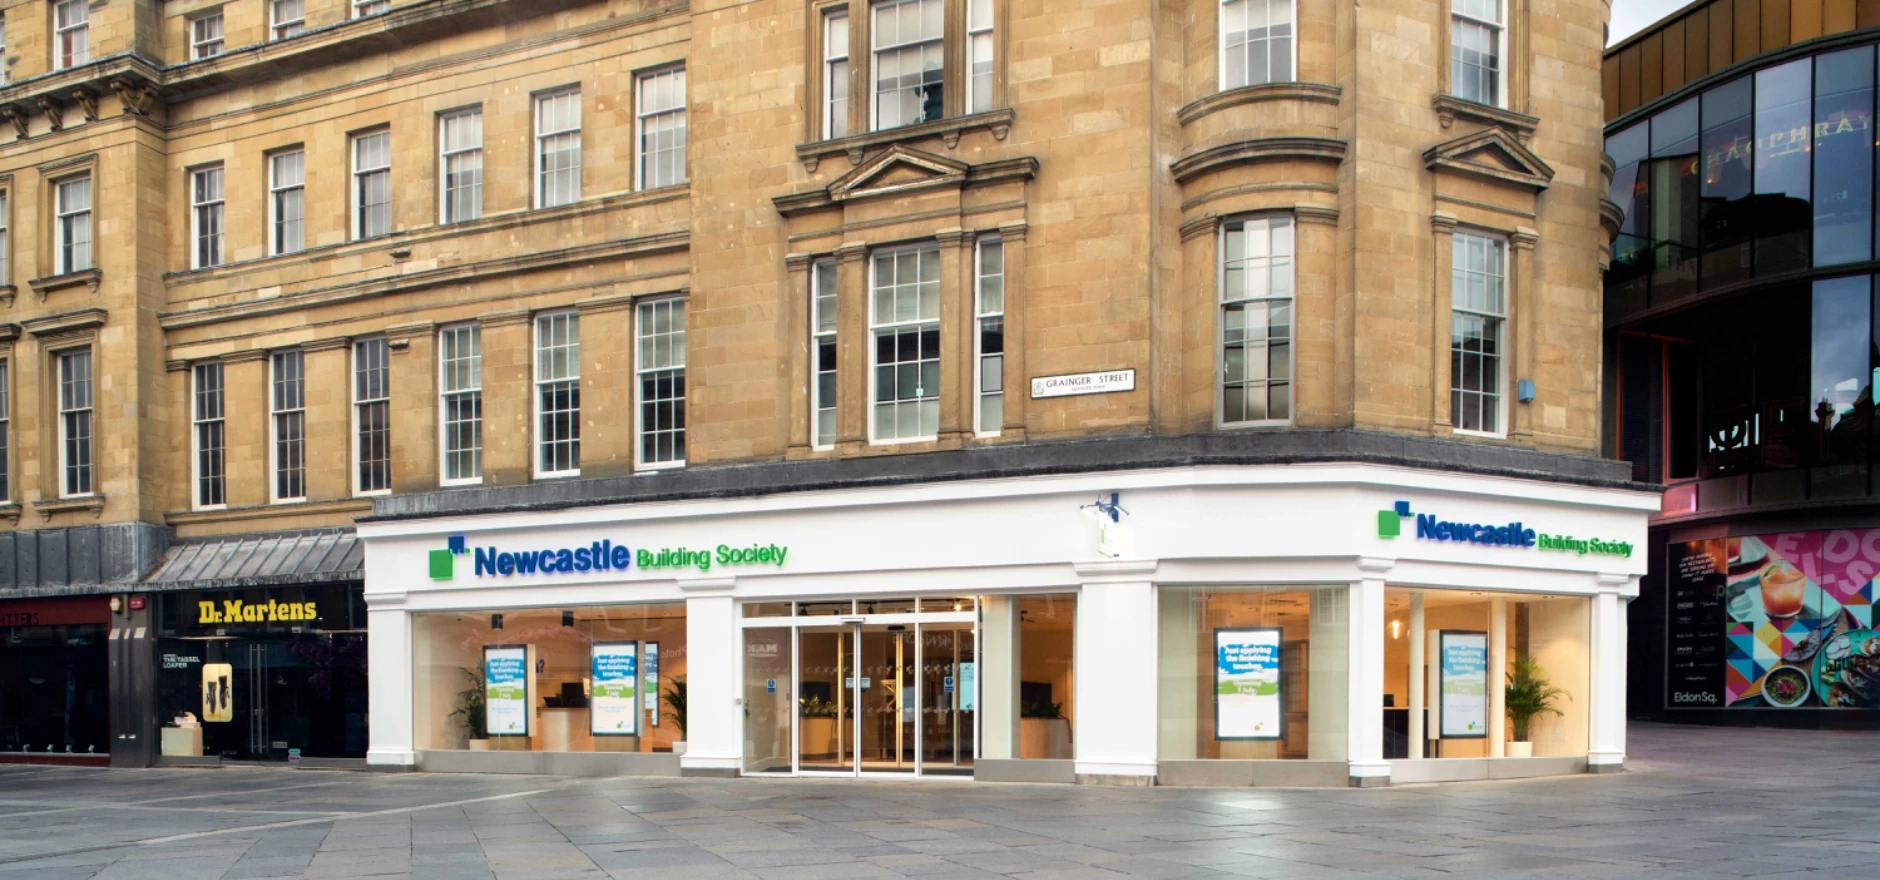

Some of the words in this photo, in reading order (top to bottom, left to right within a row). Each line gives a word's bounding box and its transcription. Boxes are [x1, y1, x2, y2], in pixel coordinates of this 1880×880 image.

[1046, 377, 1092, 388] GRAINGER
[1098, 373, 1128, 382] STREET
[1416, 514, 1536, 547] Newcastle
[1538, 534, 1588, 555] Building
[1590, 537, 1634, 558] Society
[474, 539, 630, 578] Newcastle
[636, 546, 711, 571] Building
[716, 543, 788, 568] Society
[1240, 646, 1272, 655] applying
